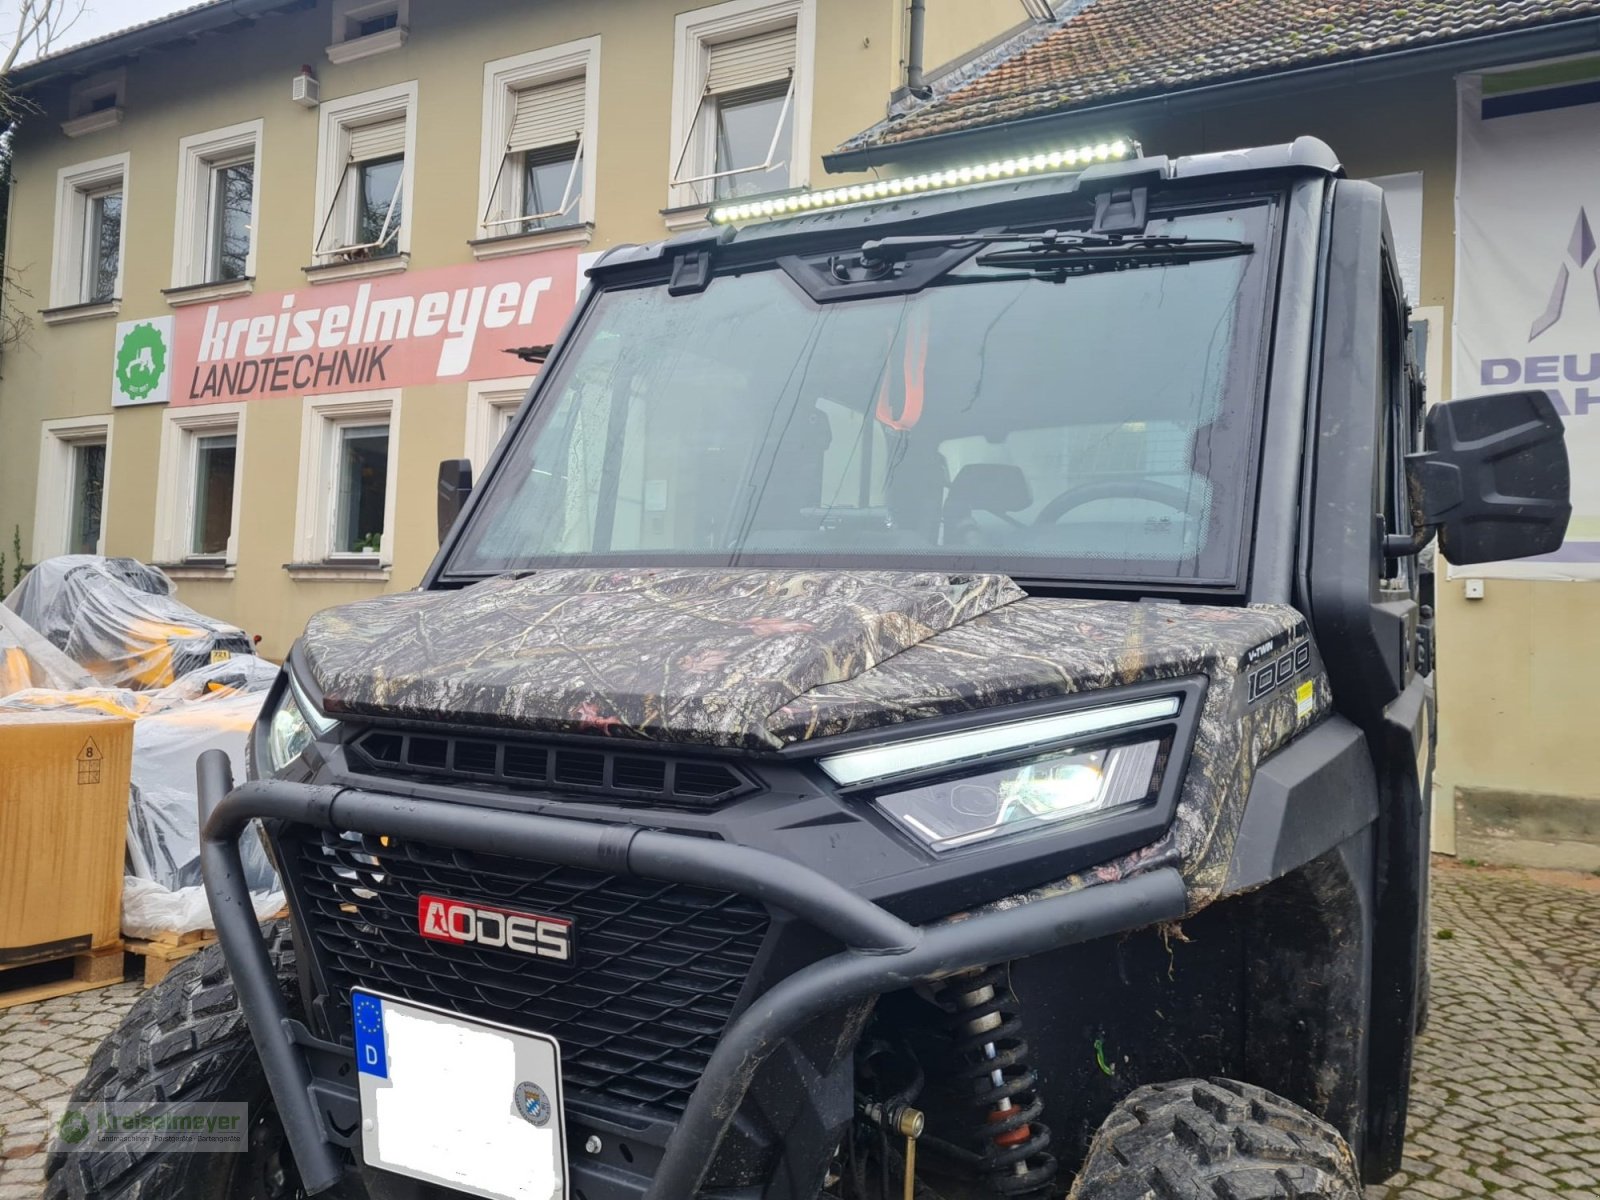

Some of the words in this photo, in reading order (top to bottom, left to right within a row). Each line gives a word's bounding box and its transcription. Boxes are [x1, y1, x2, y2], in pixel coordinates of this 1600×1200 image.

[198, 277, 552, 376] kreiselmeyer
[189, 344, 393, 399] LANDTECHNIK
[1247, 638, 1311, 704] 1000
[86, 747, 93, 758] 8
[424, 901, 568, 960] AODES
[365, 1043, 378, 1065] D
